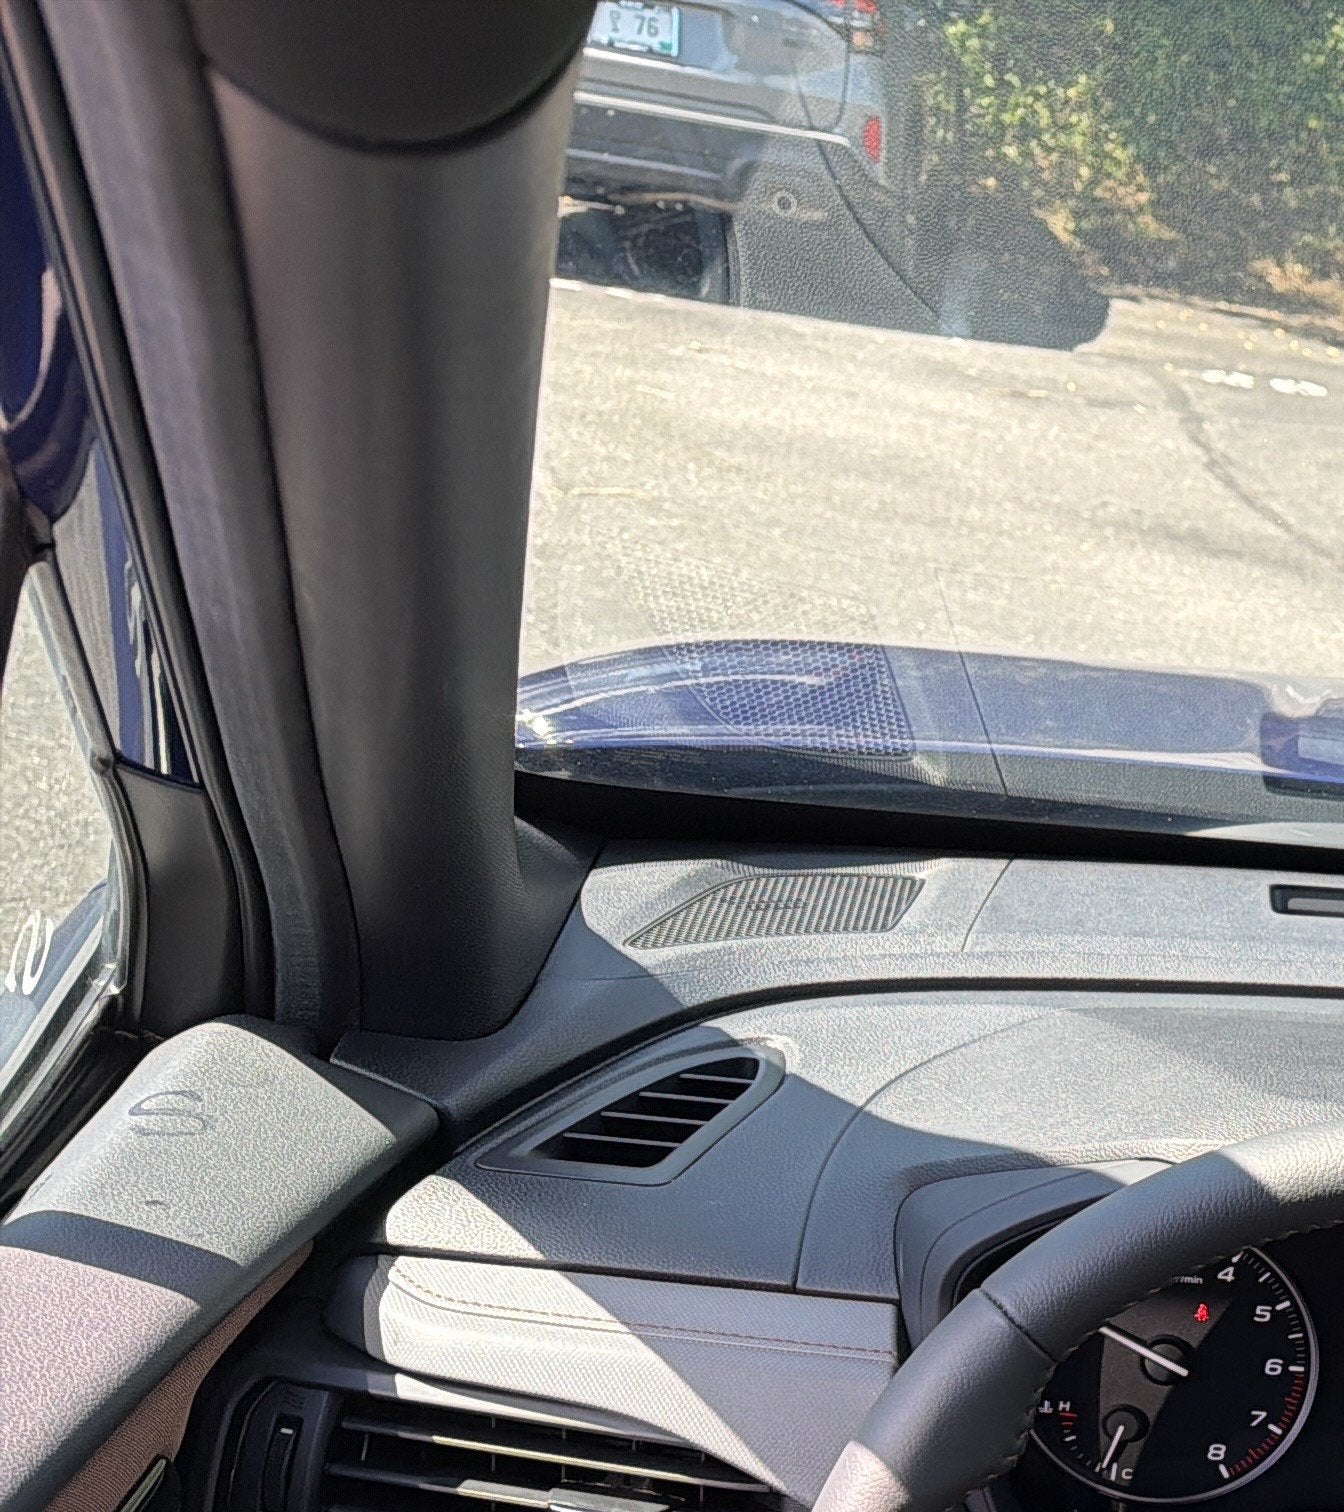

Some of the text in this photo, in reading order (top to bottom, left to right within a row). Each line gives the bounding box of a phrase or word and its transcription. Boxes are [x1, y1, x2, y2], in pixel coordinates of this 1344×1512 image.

[1217, 1266, 1236, 1282] 4
[1253, 1305, 1273, 1322] 5
[1264, 1359, 1284, 1376] 6
[1058, 1401, 1070, 1412] H
[1249, 1411, 1268, 1427] 7
[1207, 1444, 1227, 1461] 8
[1121, 1467, 1134, 1480] C
